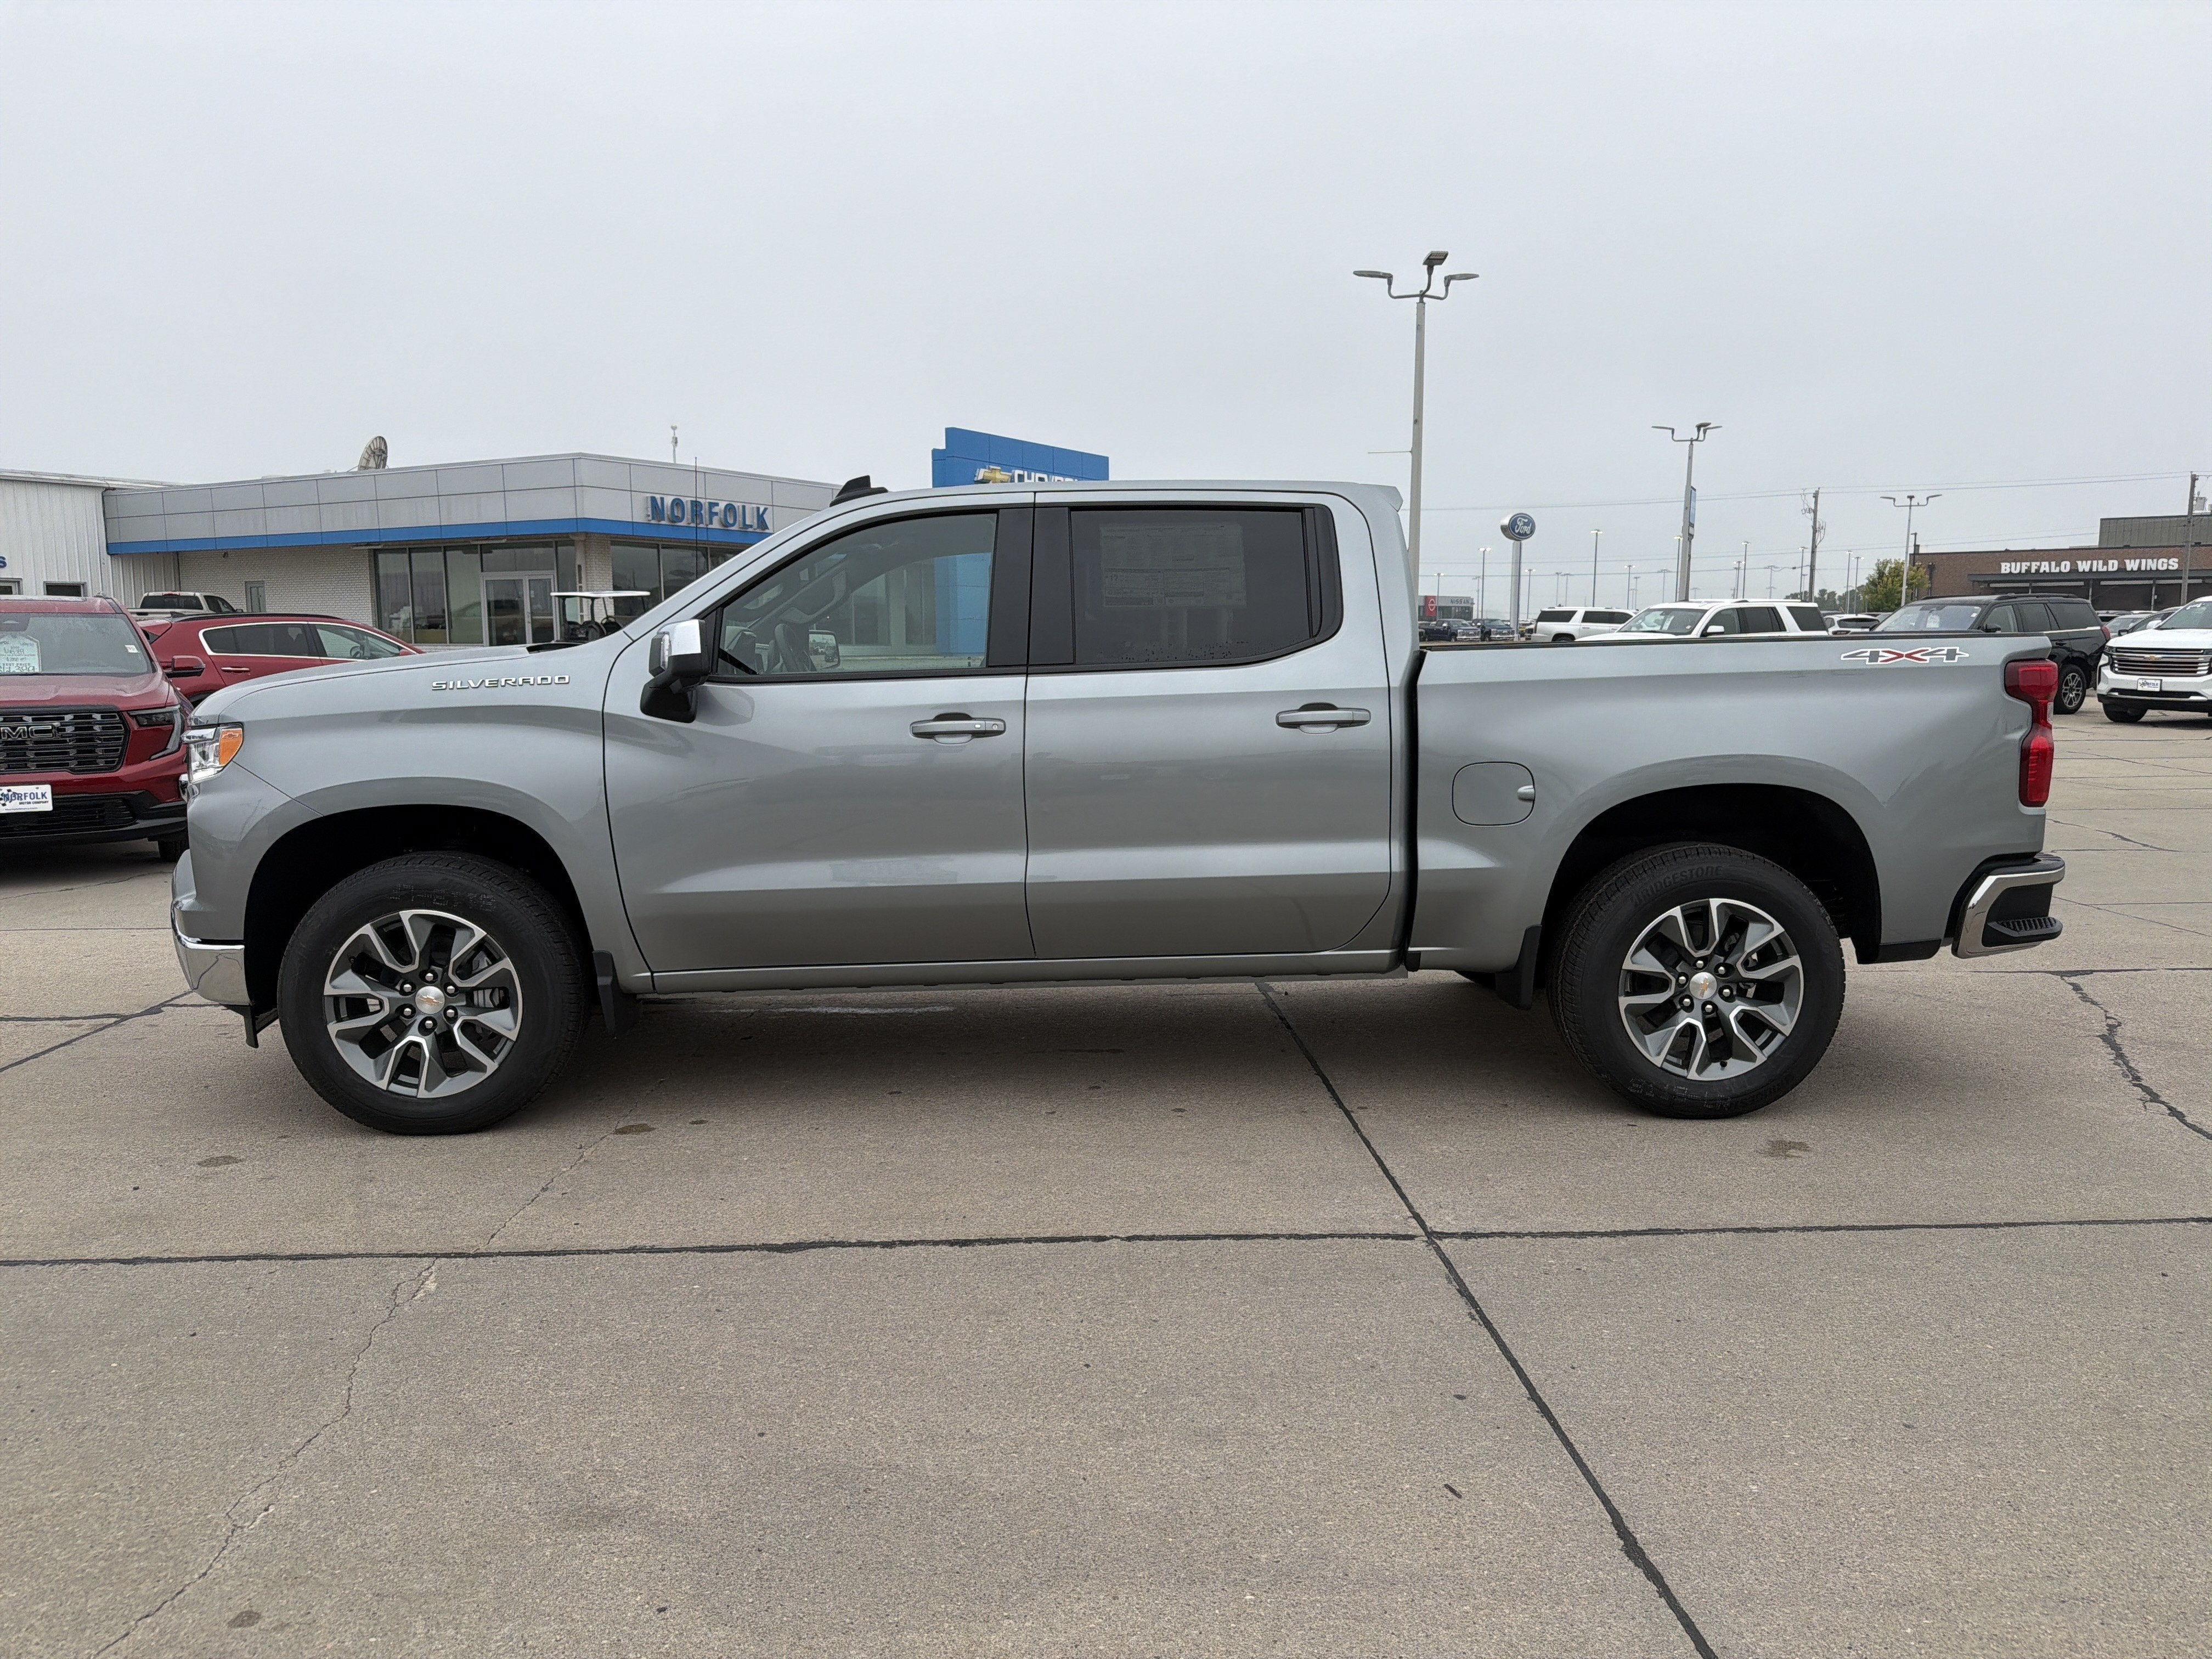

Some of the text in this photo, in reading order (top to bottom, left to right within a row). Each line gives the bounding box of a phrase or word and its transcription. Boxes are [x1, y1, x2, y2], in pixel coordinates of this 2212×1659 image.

[648, 495, 770, 531] NORFOLK
[1515, 517, 1532, 534] Ford
[2000, 557, 2179, 574] BUFFALO WILD WINGS
[432, 675, 570, 691] SILVERADO
[3, 792, 48, 802] NORFOLK
